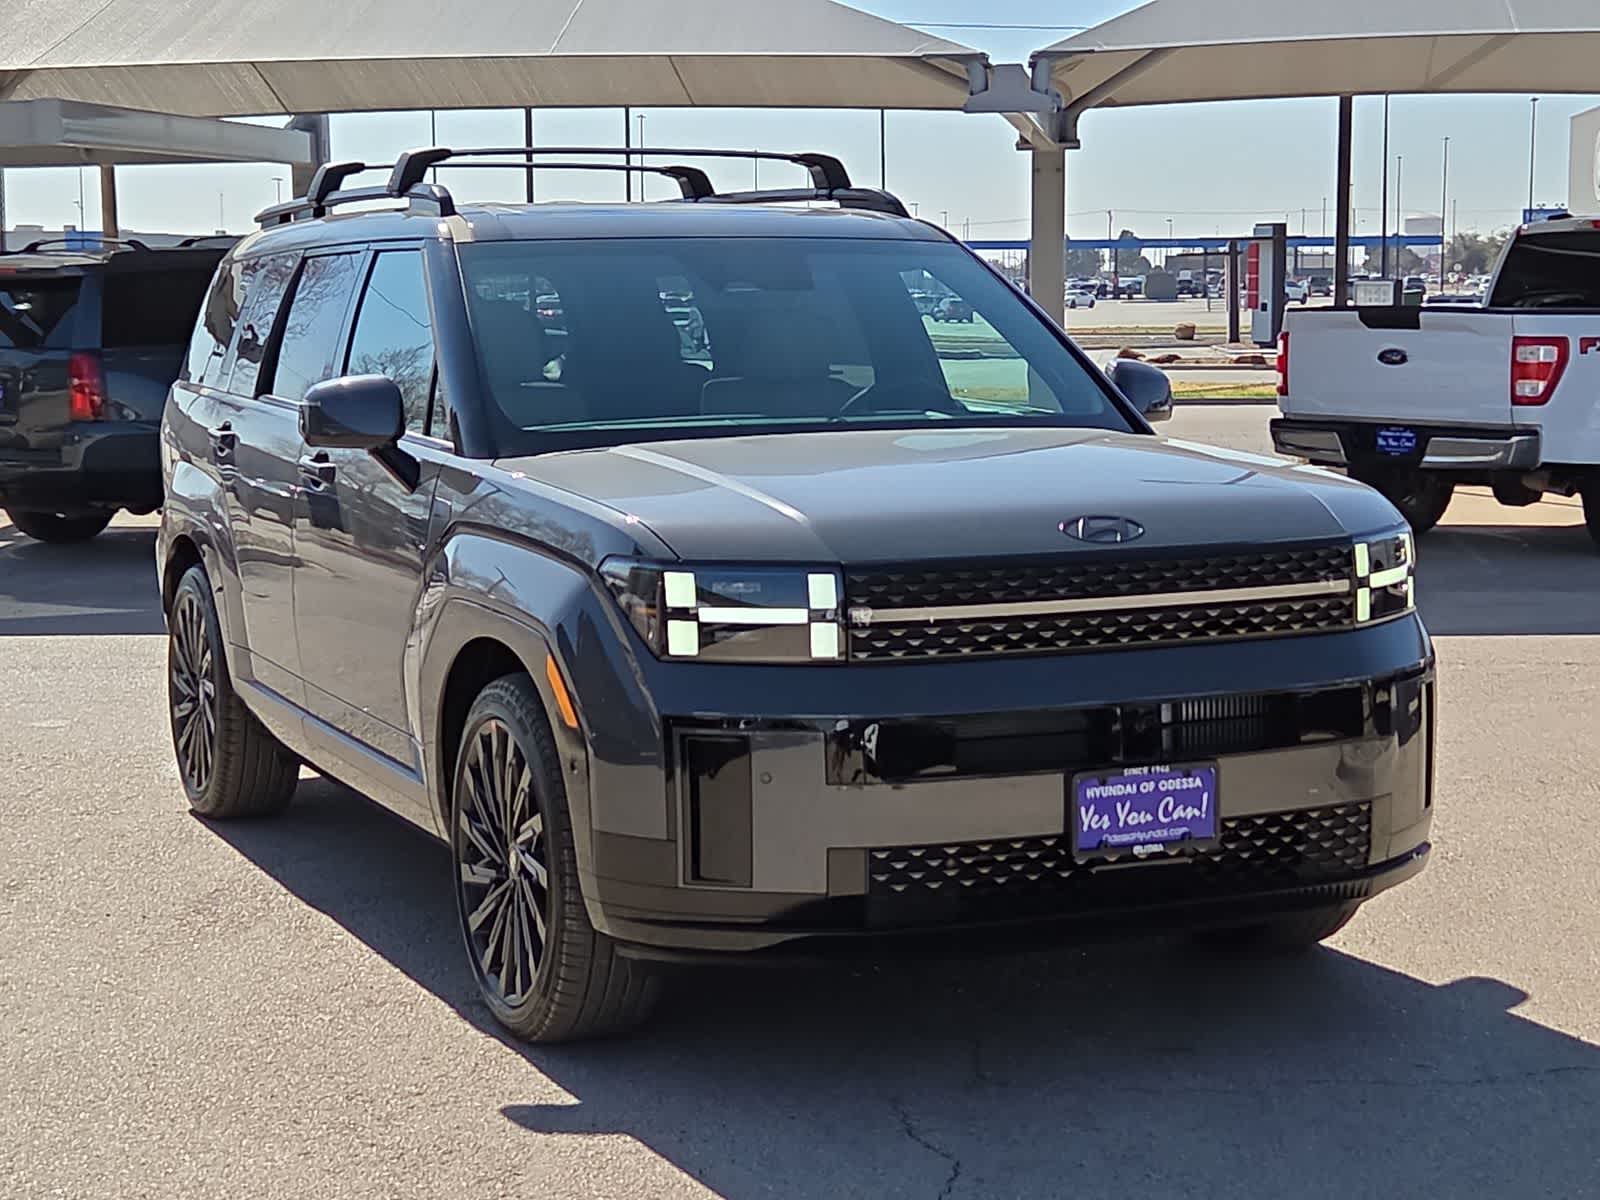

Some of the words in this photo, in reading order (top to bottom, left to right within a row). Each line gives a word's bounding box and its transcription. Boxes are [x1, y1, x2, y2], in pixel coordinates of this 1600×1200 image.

[1086, 783, 1137, 799] HYUNDAI
[1139, 781, 1155, 793] OF
[1158, 775, 1203, 791] ODESSA
[1080, 804, 1111, 832] Yes
[1116, 800, 1153, 828] You
[1158, 791, 1209, 823] Can!
